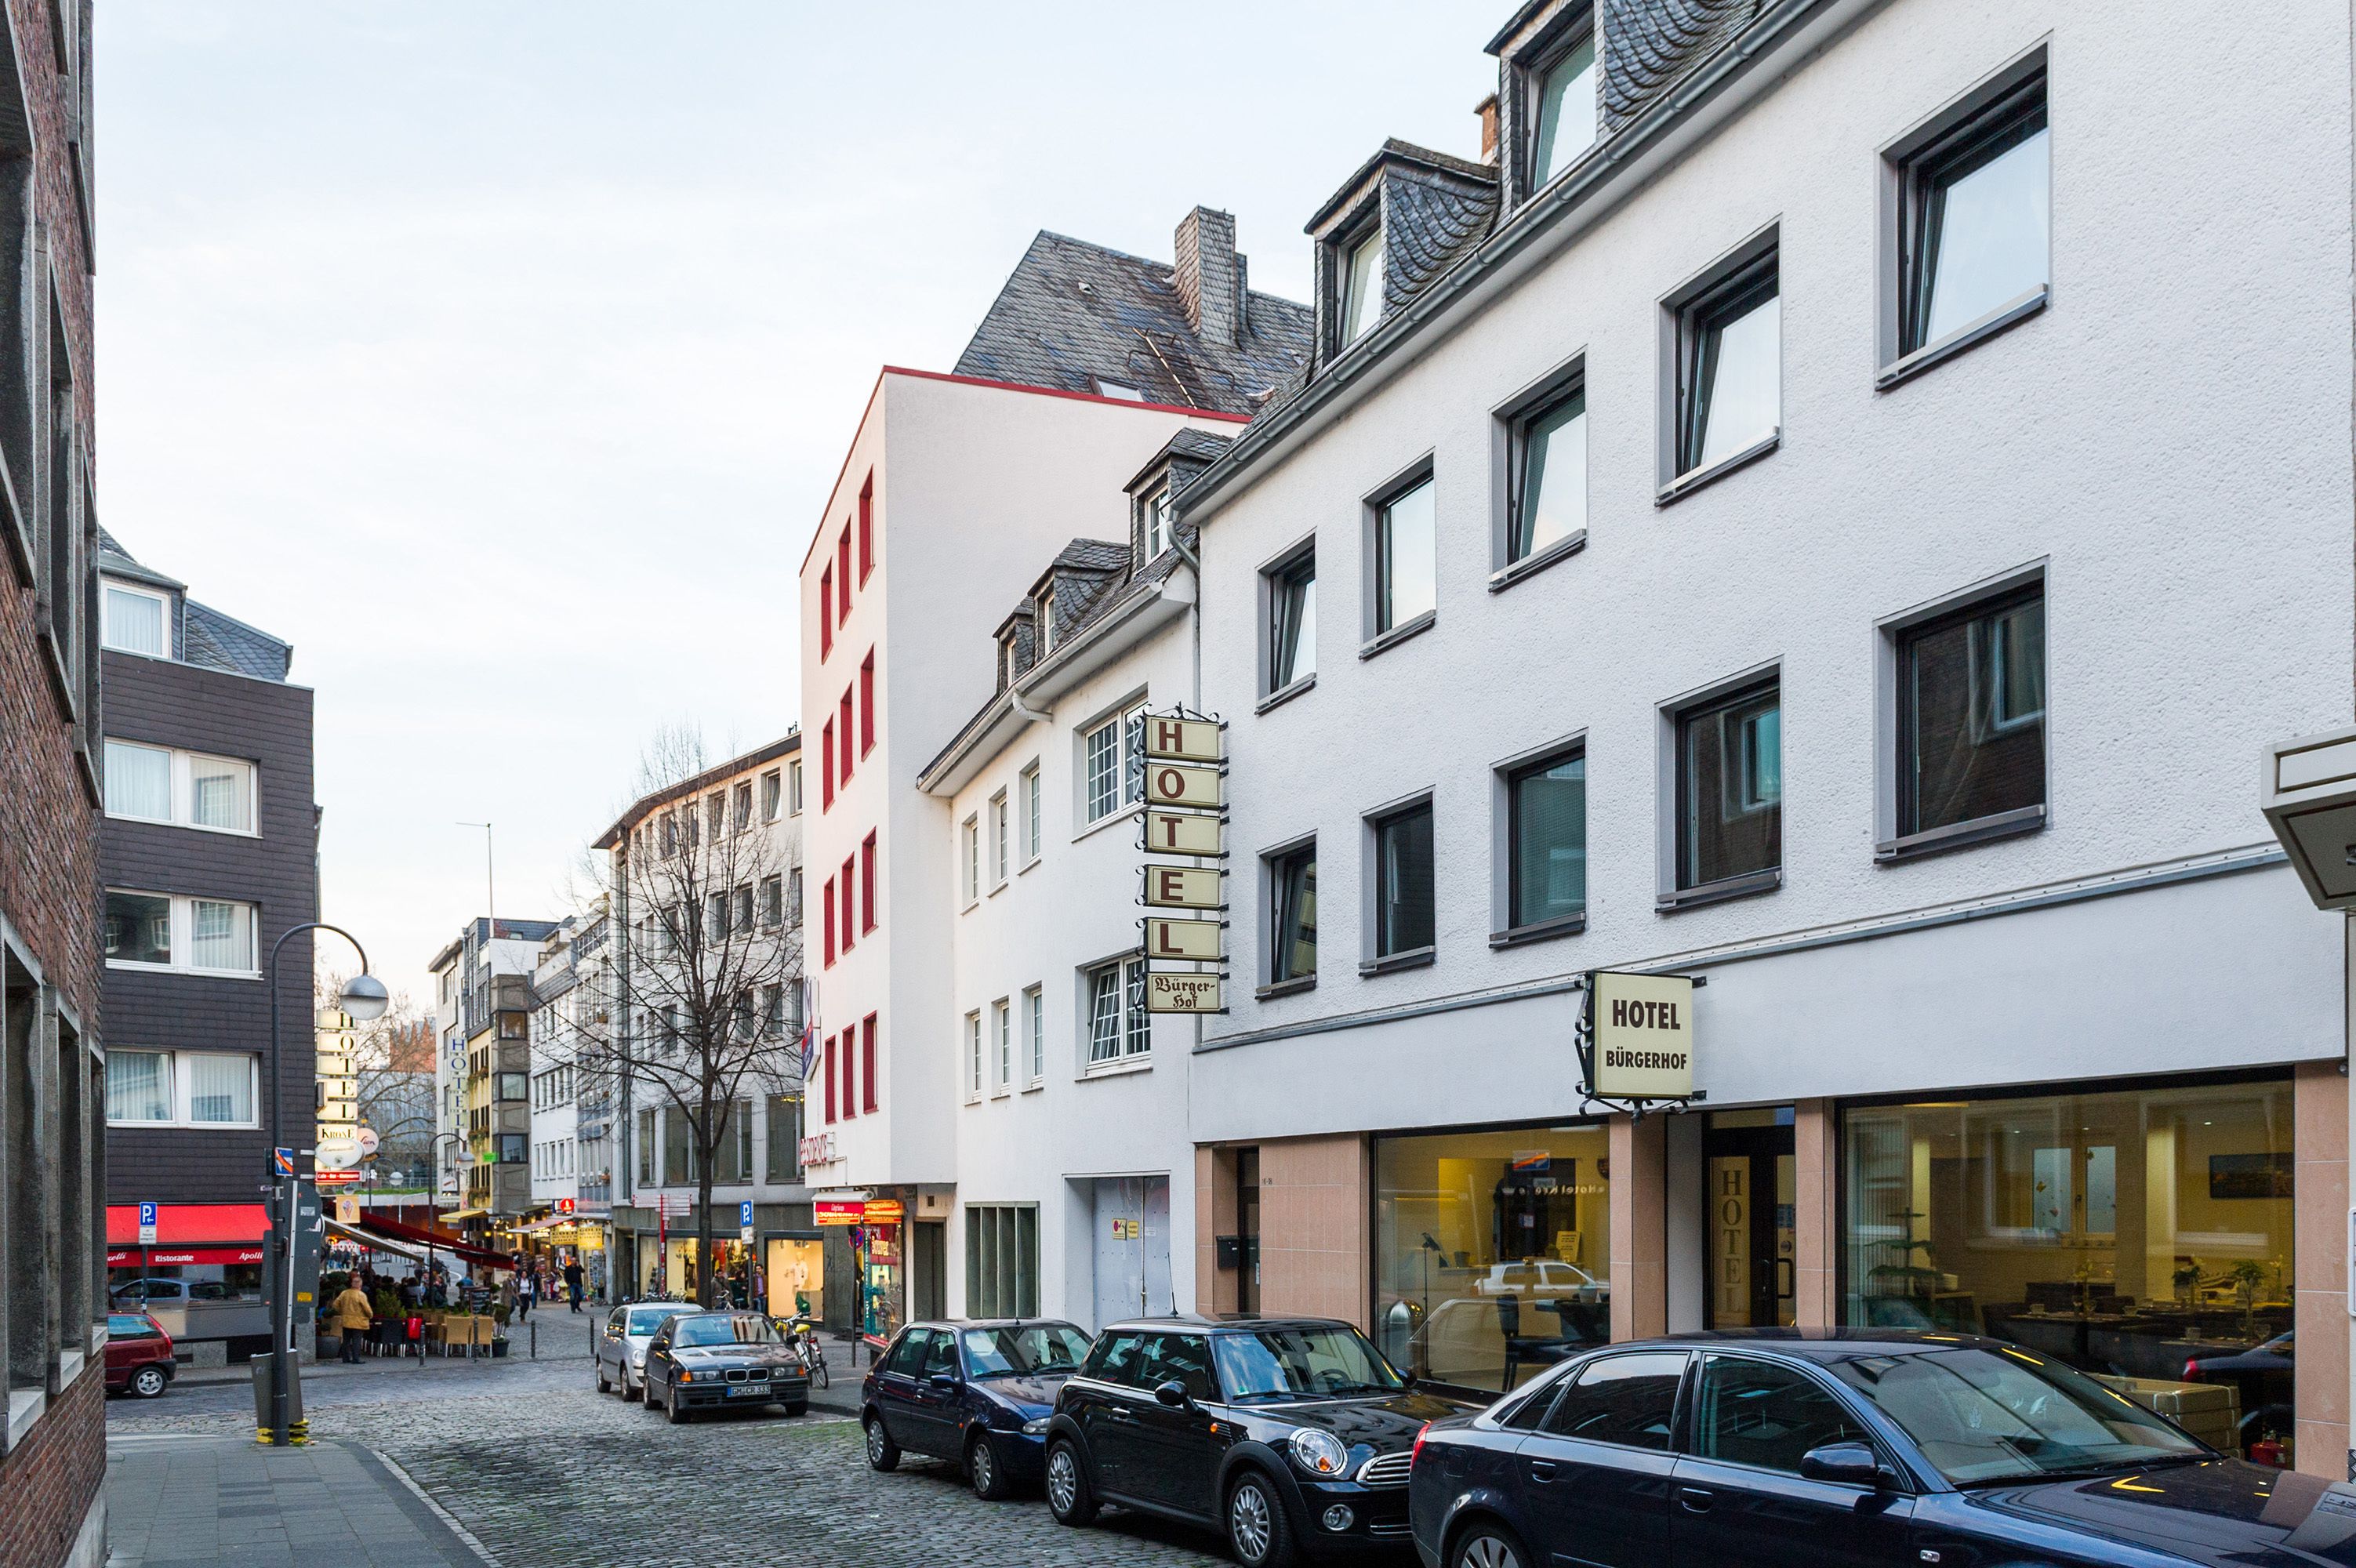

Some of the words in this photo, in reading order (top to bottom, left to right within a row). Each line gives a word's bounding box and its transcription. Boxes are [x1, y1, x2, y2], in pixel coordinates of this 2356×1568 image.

[1158, 720, 1185, 954] HOTEL
[1155, 977, 1215, 997] Bürger-
[1173, 992, 1198, 1009] Hof
[1613, 1000, 1681, 1030] HOTEL
[339, 1013, 354, 1119] HOTEL
[1606, 1046, 1686, 1069] BÜRGERHOF
[452, 1039, 466, 1127] HOTEL
[322, 1128, 354, 1139] KRONE
[1723, 1171, 1742, 1313] HOTEL
